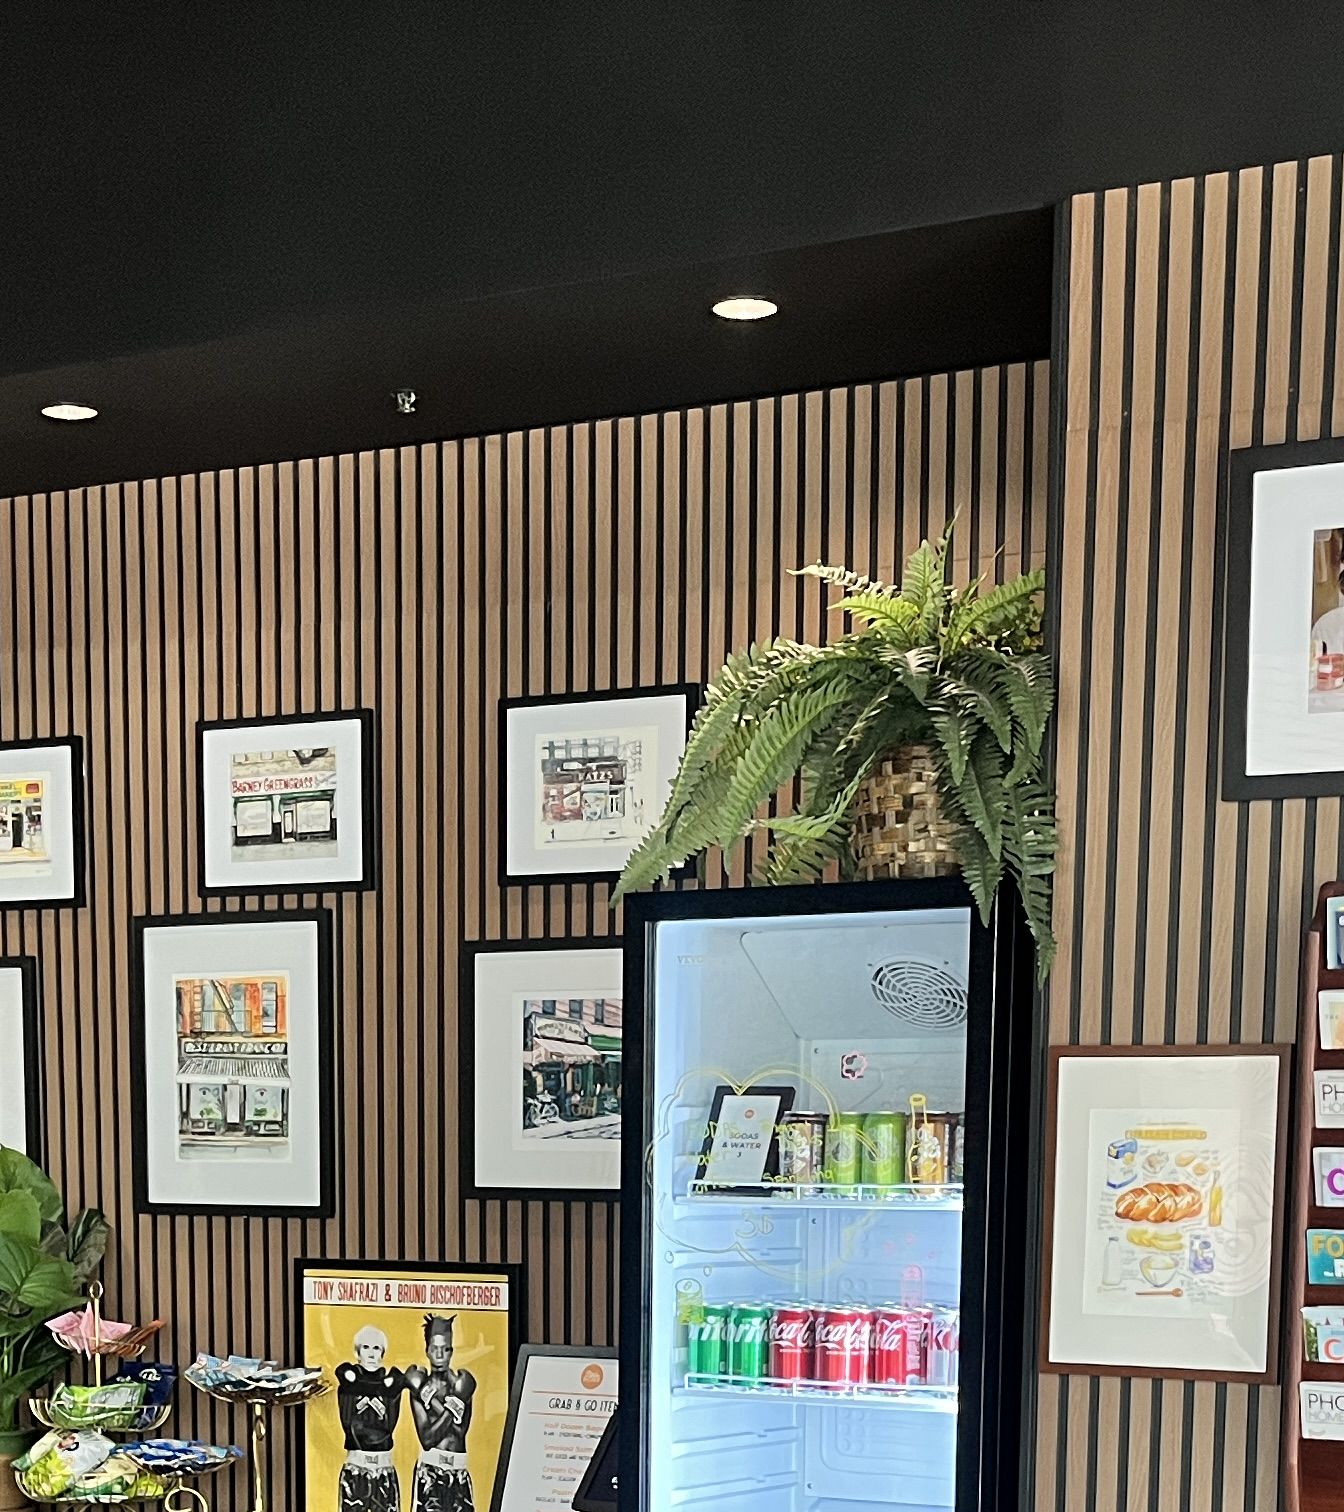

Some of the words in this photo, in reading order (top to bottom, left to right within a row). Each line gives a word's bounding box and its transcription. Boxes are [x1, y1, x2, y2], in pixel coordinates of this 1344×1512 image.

[313, 1281, 334, 1300] TONY
[337, 1281, 378, 1302] SHAFRAZI
[384, 1283, 392, 1302] &
[397, 1284, 426, 1304] BRUNO
[430, 1285, 502, 1307] BISCHOFBERGER
[548, 1397, 573, 1410] GRAB
[584, 1399, 598, 1411] GO
